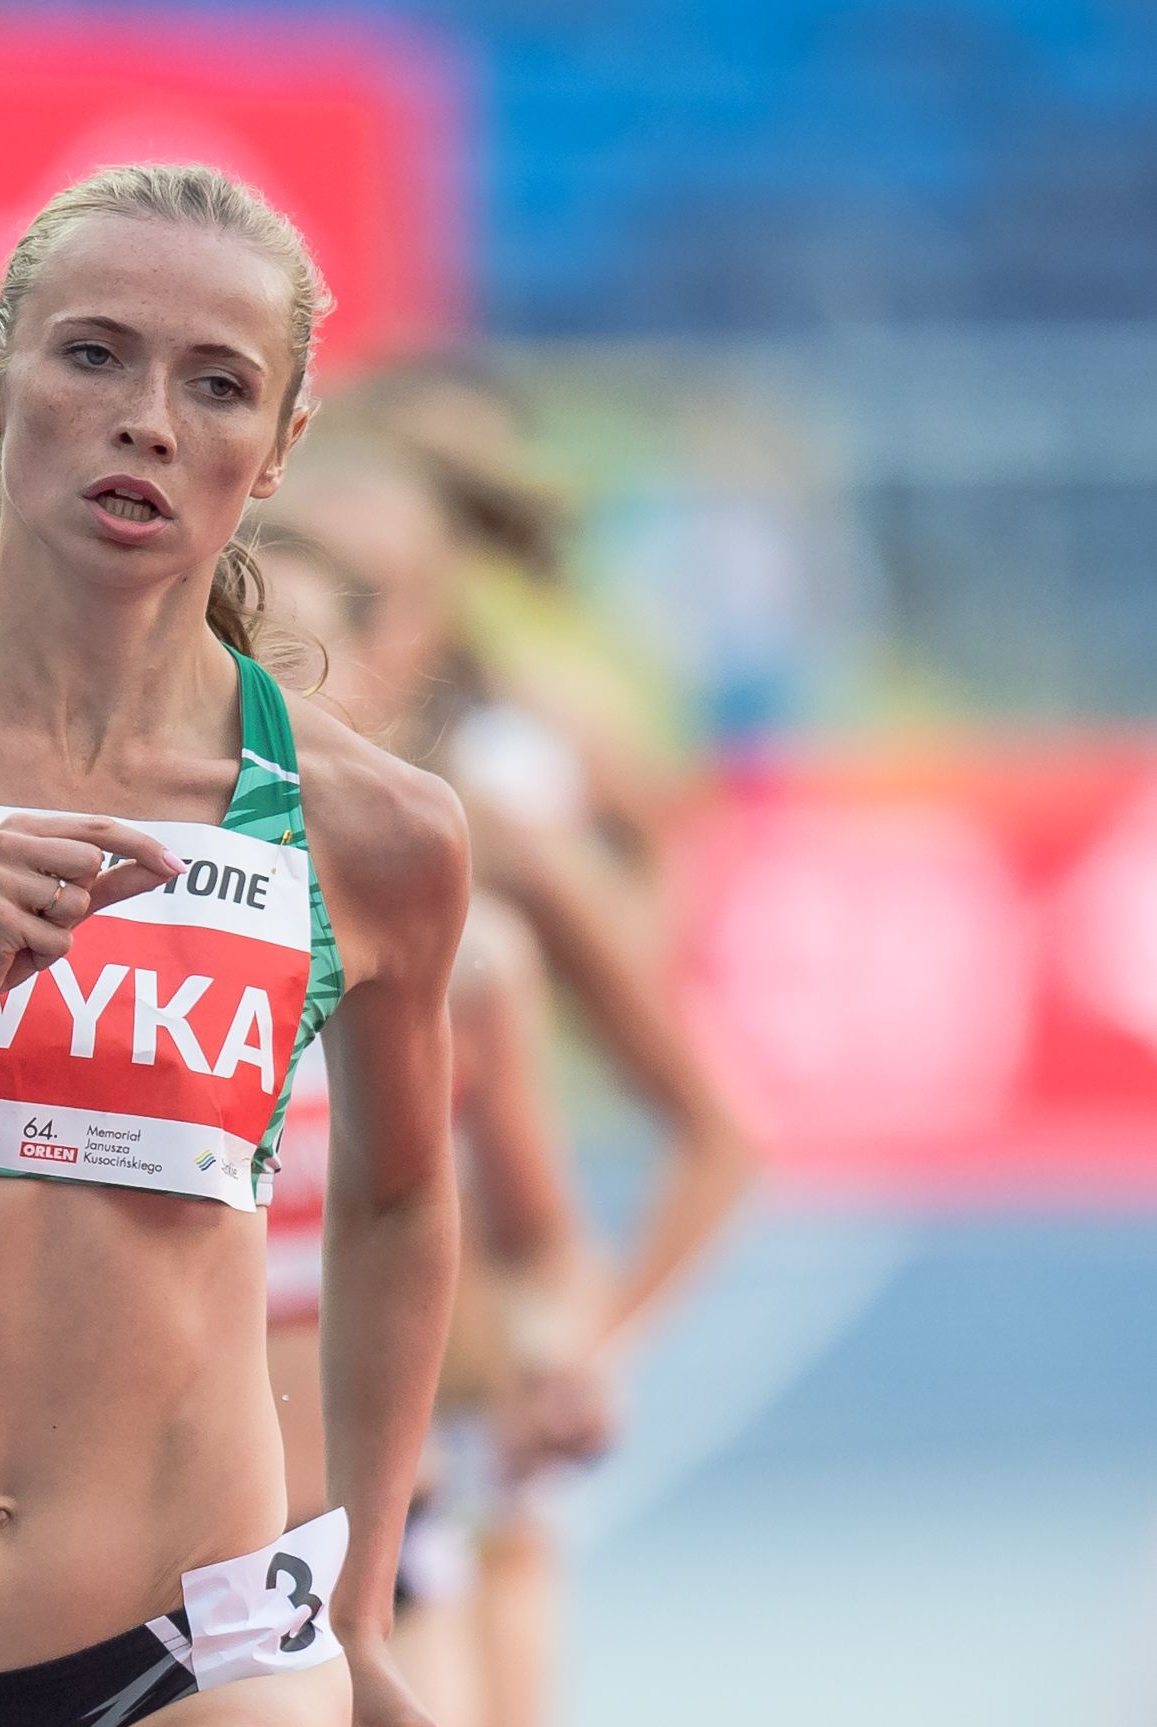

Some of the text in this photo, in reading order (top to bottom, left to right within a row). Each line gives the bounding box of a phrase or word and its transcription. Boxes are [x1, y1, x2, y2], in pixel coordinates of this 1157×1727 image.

[23, 1116, 58, 1140] 64.
[86, 1125, 141, 1142] Memoriał
[23, 1143, 75, 1161] ORLEN
[85, 1138, 130, 1154] Janusza
[83, 1152, 163, 1175] Kusocińskiego
[266, 1552, 323, 1652] 3
